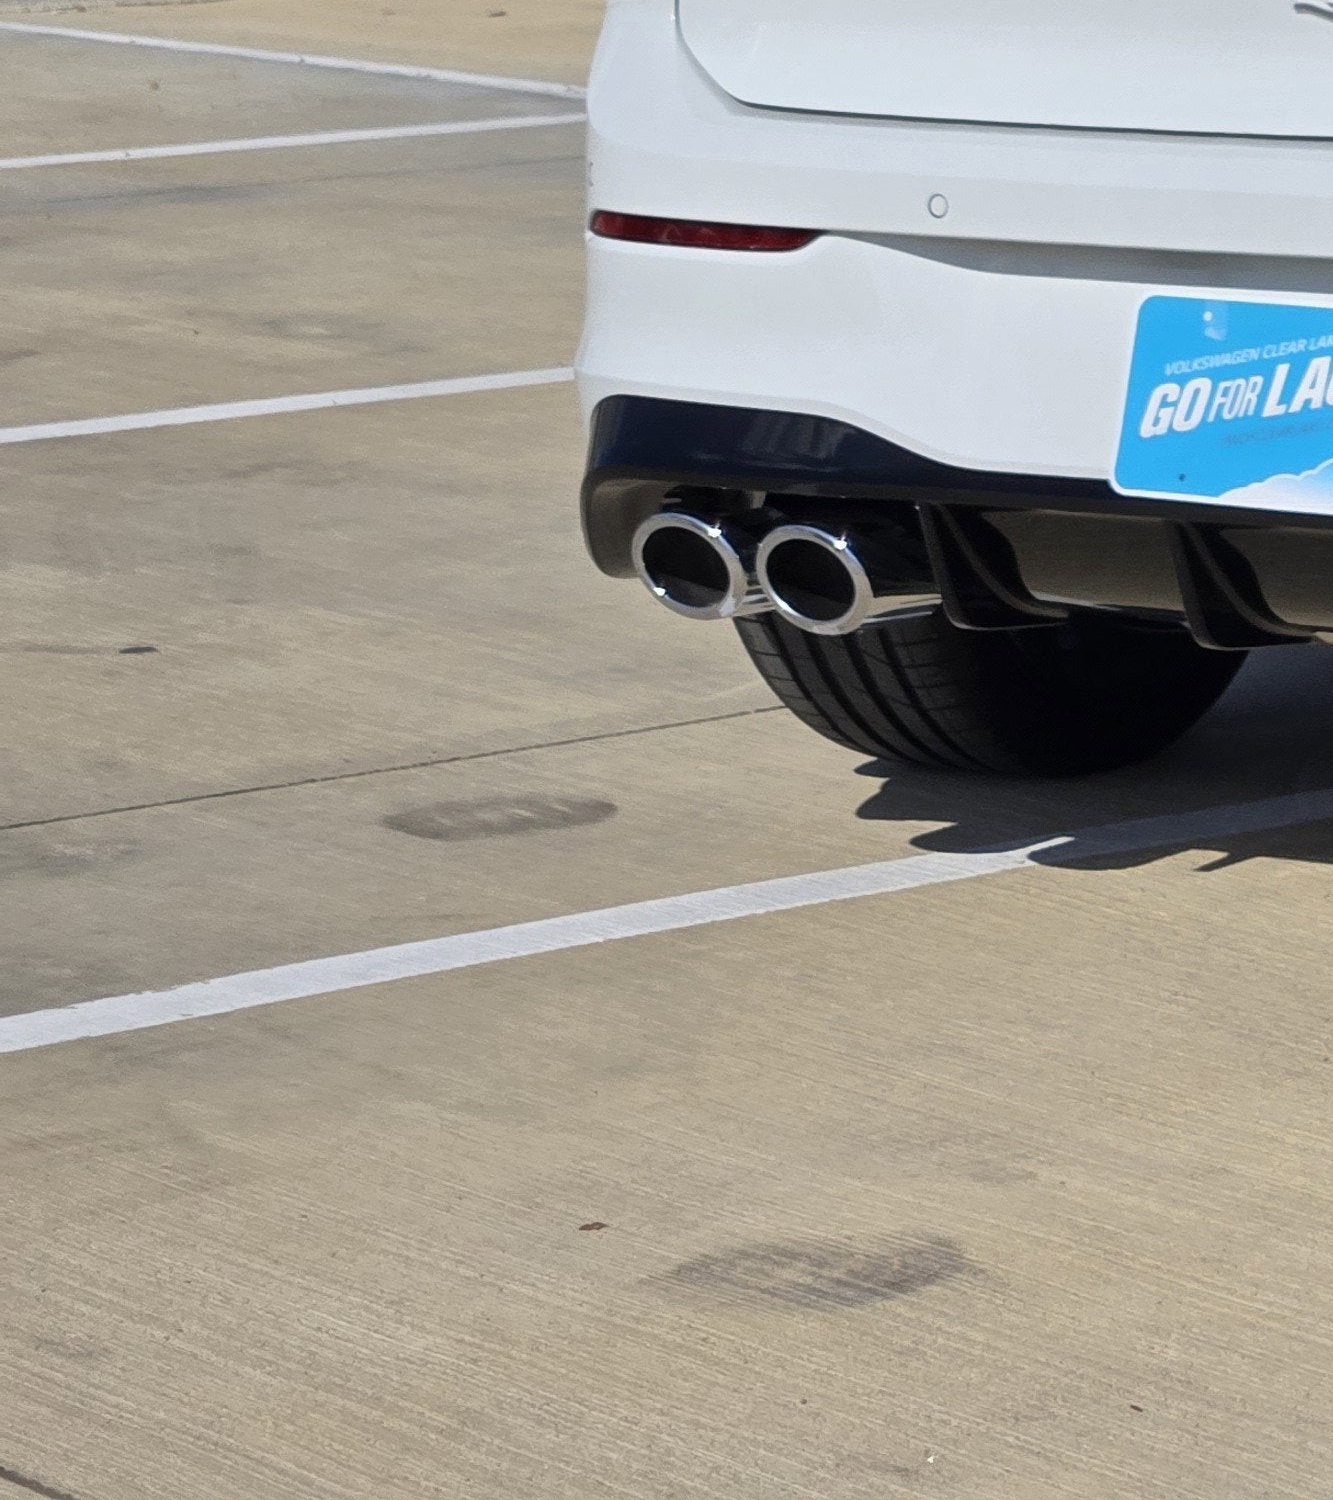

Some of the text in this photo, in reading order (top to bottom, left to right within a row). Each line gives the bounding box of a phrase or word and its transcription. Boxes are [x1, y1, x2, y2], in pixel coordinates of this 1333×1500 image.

[1164, 347, 1260, 376] VOLKSWAGEN
[1262, 338, 1306, 359] CLEAR
[1139, 377, 1212, 439] GO
[1207, 375, 1264, 423] FOR
